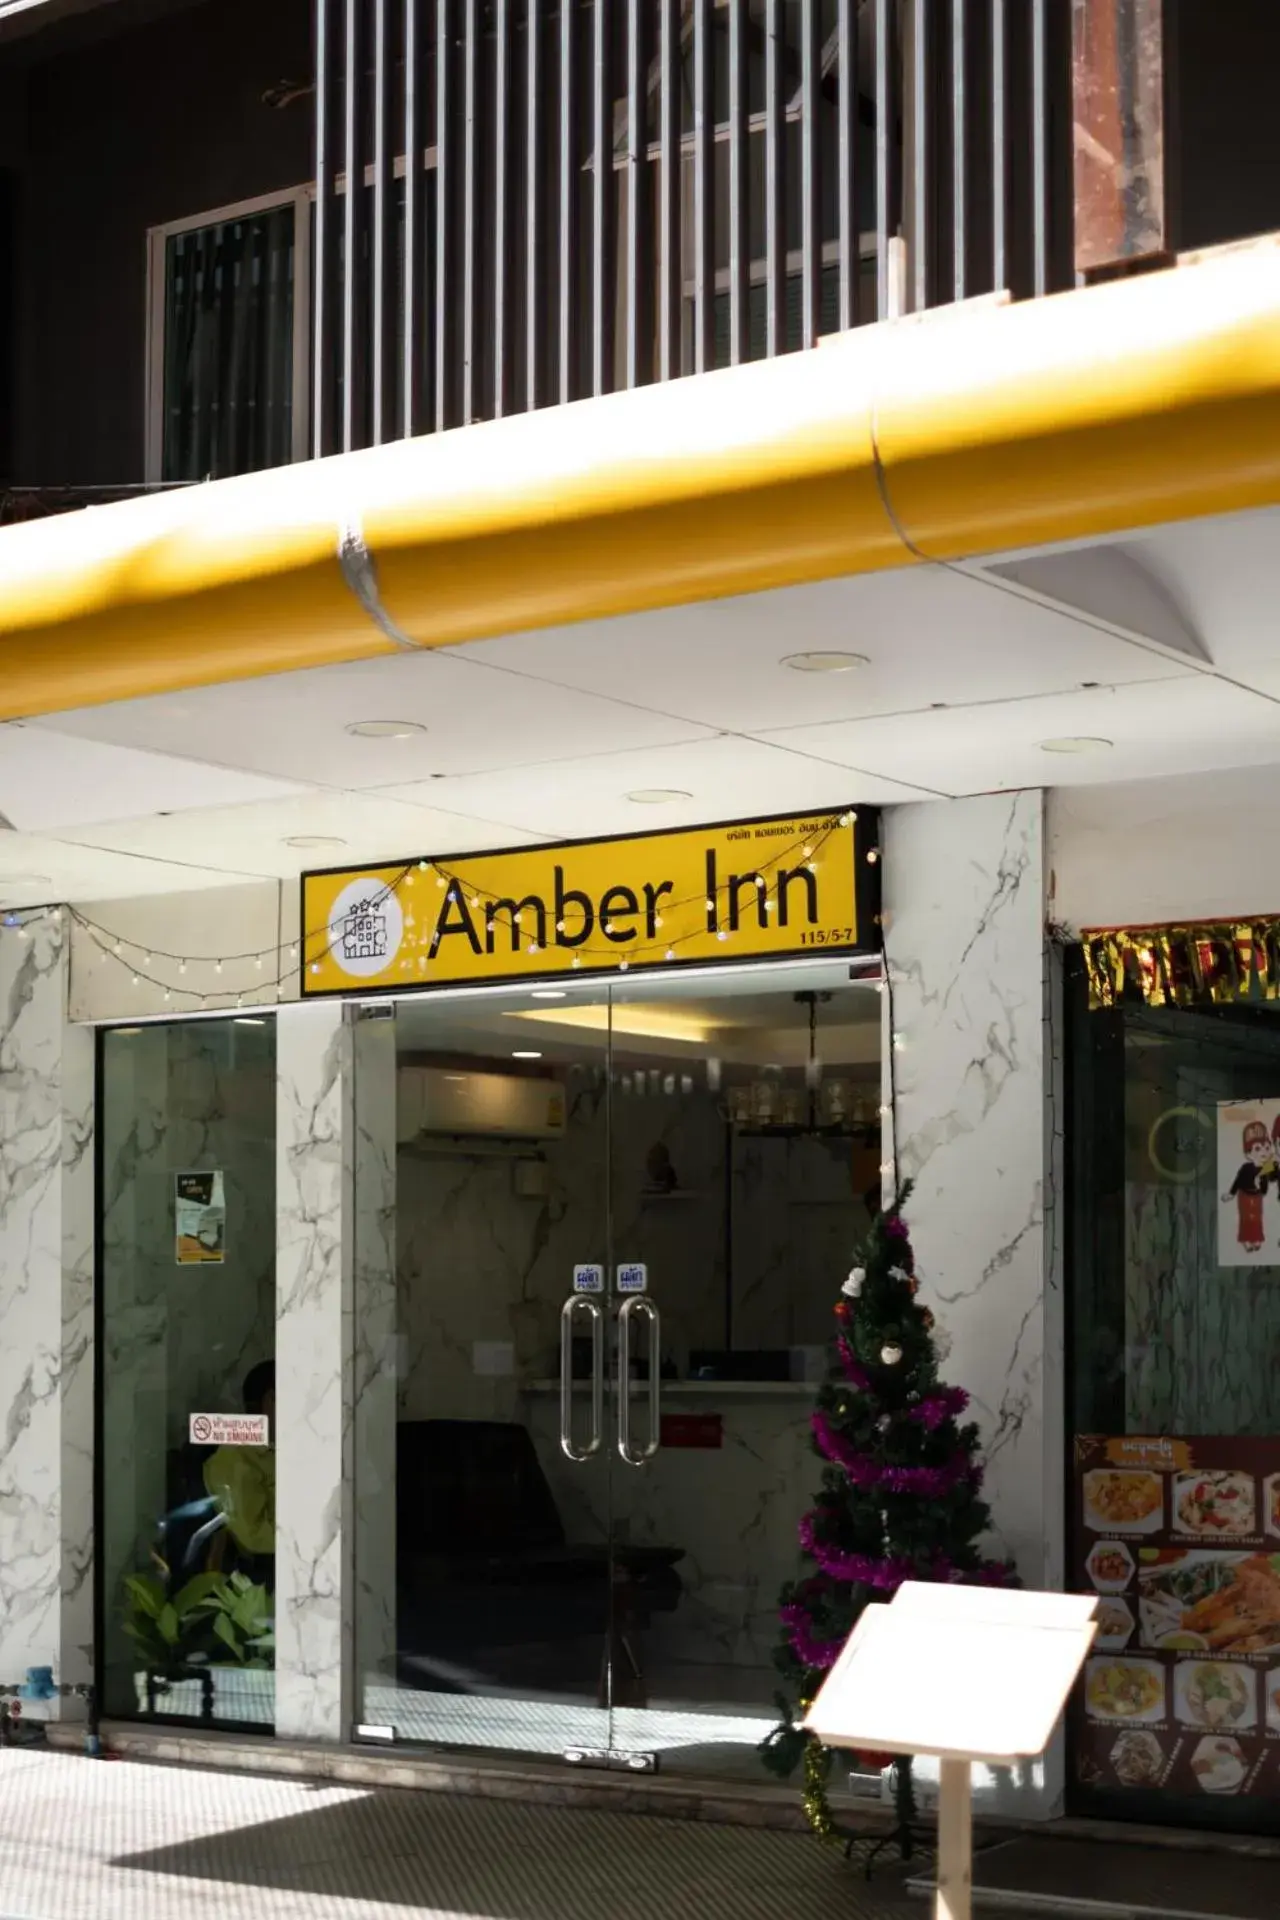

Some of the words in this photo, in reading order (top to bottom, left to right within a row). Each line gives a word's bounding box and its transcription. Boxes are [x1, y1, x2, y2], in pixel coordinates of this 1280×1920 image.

[428, 865, 674, 960] Amber
[706, 848, 820, 933] Inn
[800, 928, 852, 945] 115/5-7
[213, 1431, 225, 1441] NO
